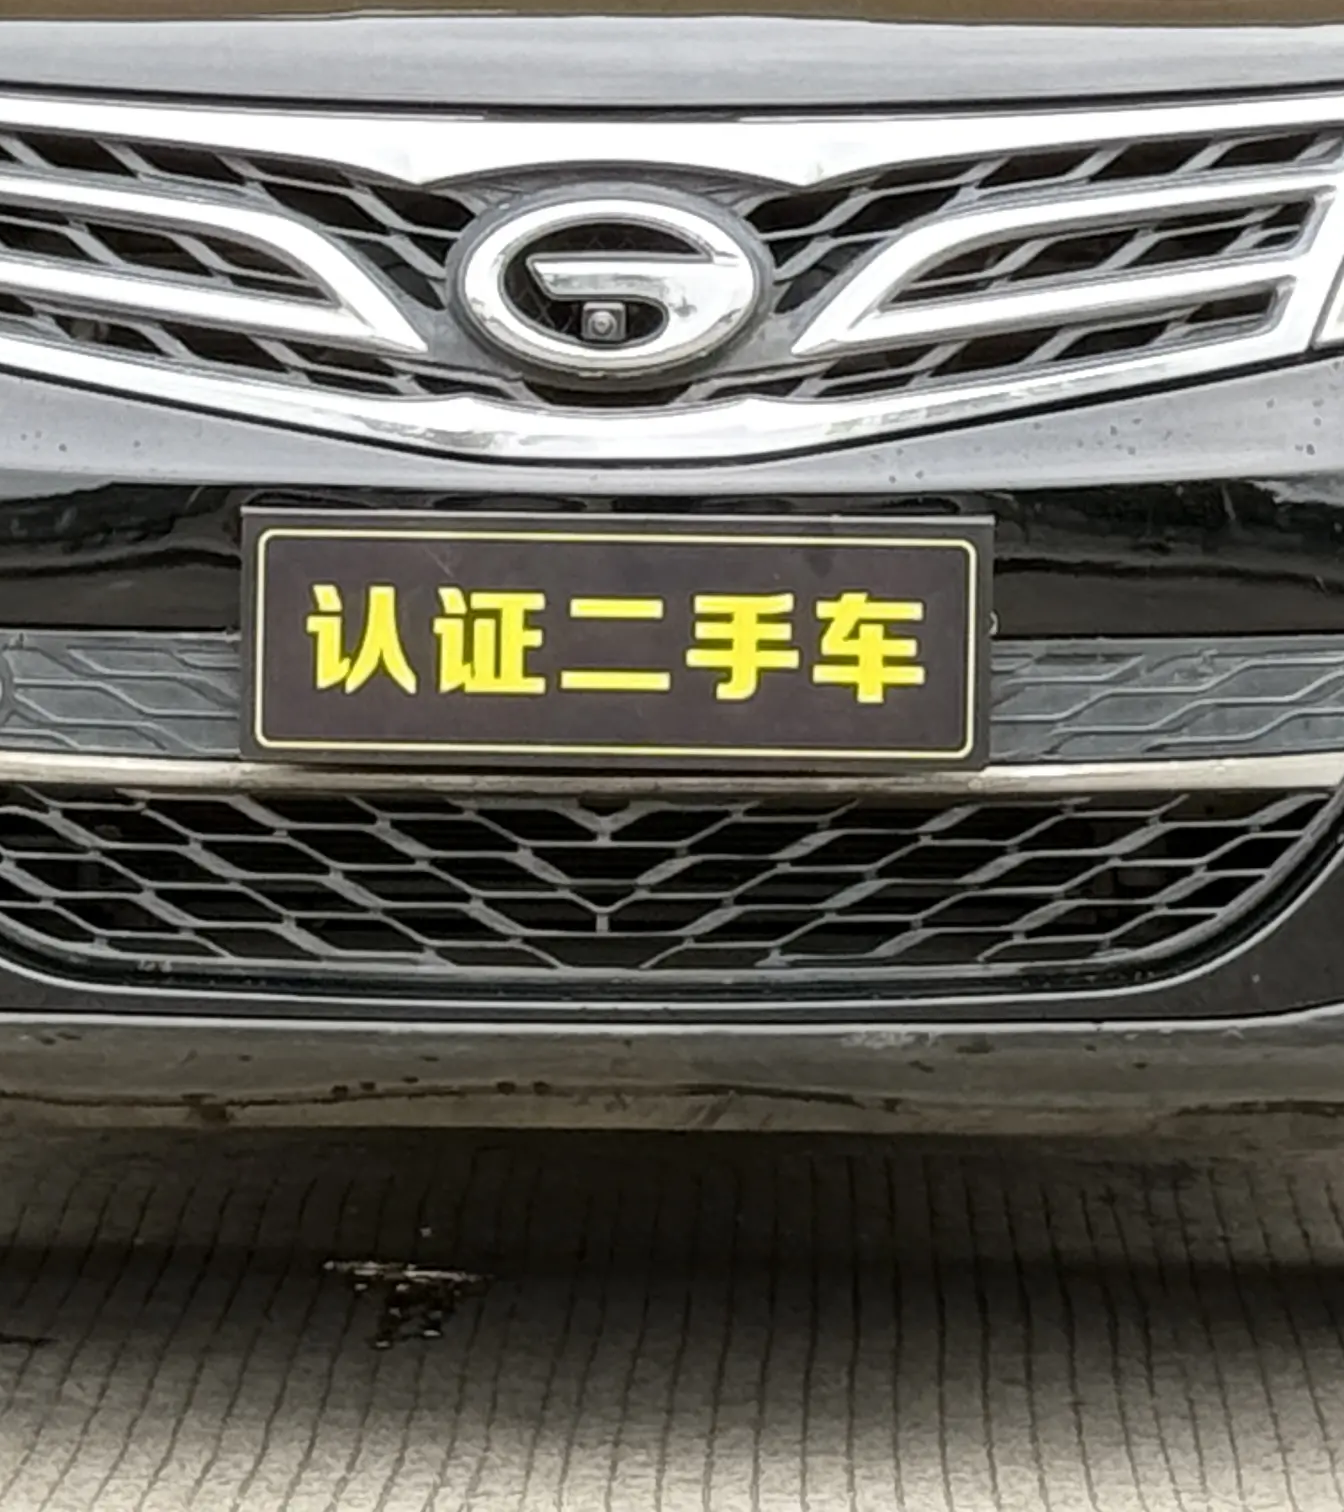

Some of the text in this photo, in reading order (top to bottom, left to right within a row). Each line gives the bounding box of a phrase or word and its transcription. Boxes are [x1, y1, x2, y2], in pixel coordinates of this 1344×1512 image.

[306, 584, 926, 704] 认证二手车
